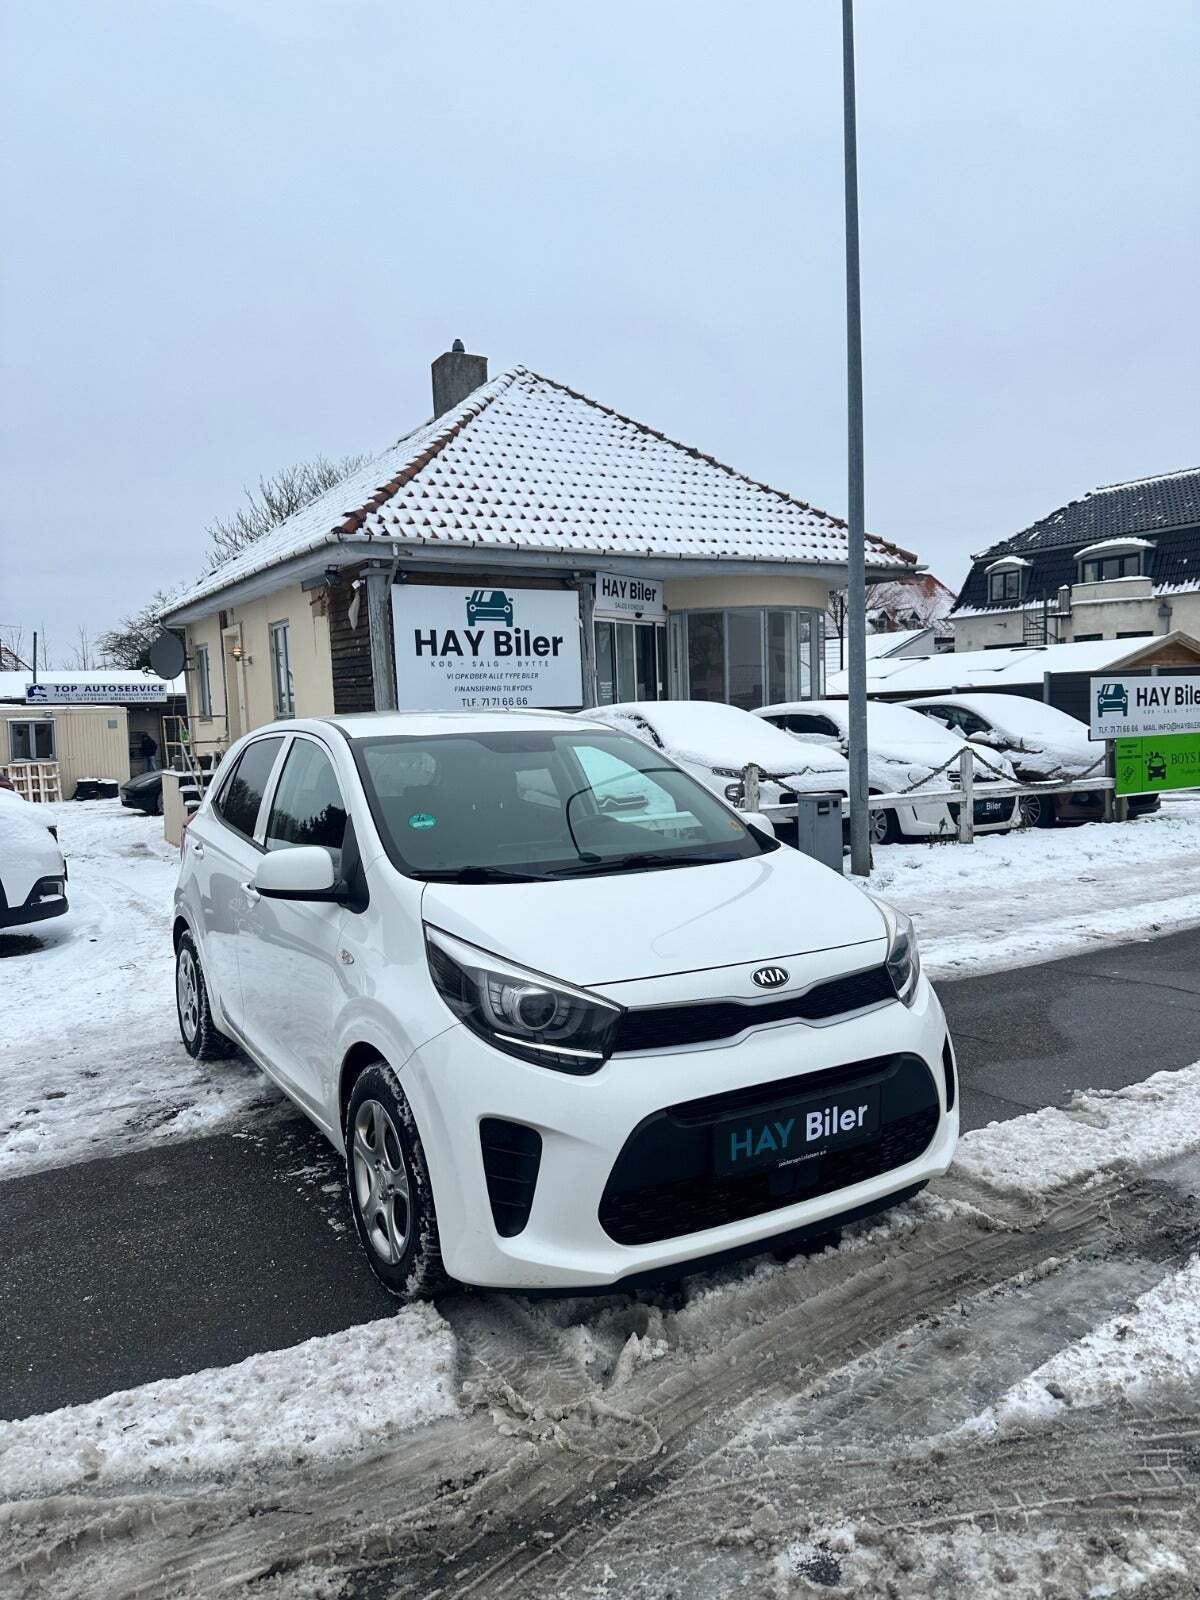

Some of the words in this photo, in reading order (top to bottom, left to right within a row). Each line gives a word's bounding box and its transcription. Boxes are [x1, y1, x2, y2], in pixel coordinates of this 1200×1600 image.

[602, 578, 627, 598] HAY
[630, 581, 657, 602] Biler
[414, 628, 485, 657] HAY
[494, 627, 564, 657] Biler
[472, 660, 499, 668] SALG
[517, 660, 549, 668] BYTTE
[488, 672, 504, 680] ALLE
[54, 685, 78, 693] TOP
[84, 684, 165, 693] AUTOSERVICE
[454, 684, 502, 693] FINANSIERING
[503, 684, 533, 692] TILBYDES
[1136, 687, 1171, 707] HAY
[986, 801, 1002, 811] Biler
[756, 968, 787, 984] KIA
[730, 1118, 796, 1162] HAY
[806, 1104, 868, 1142] Biler
